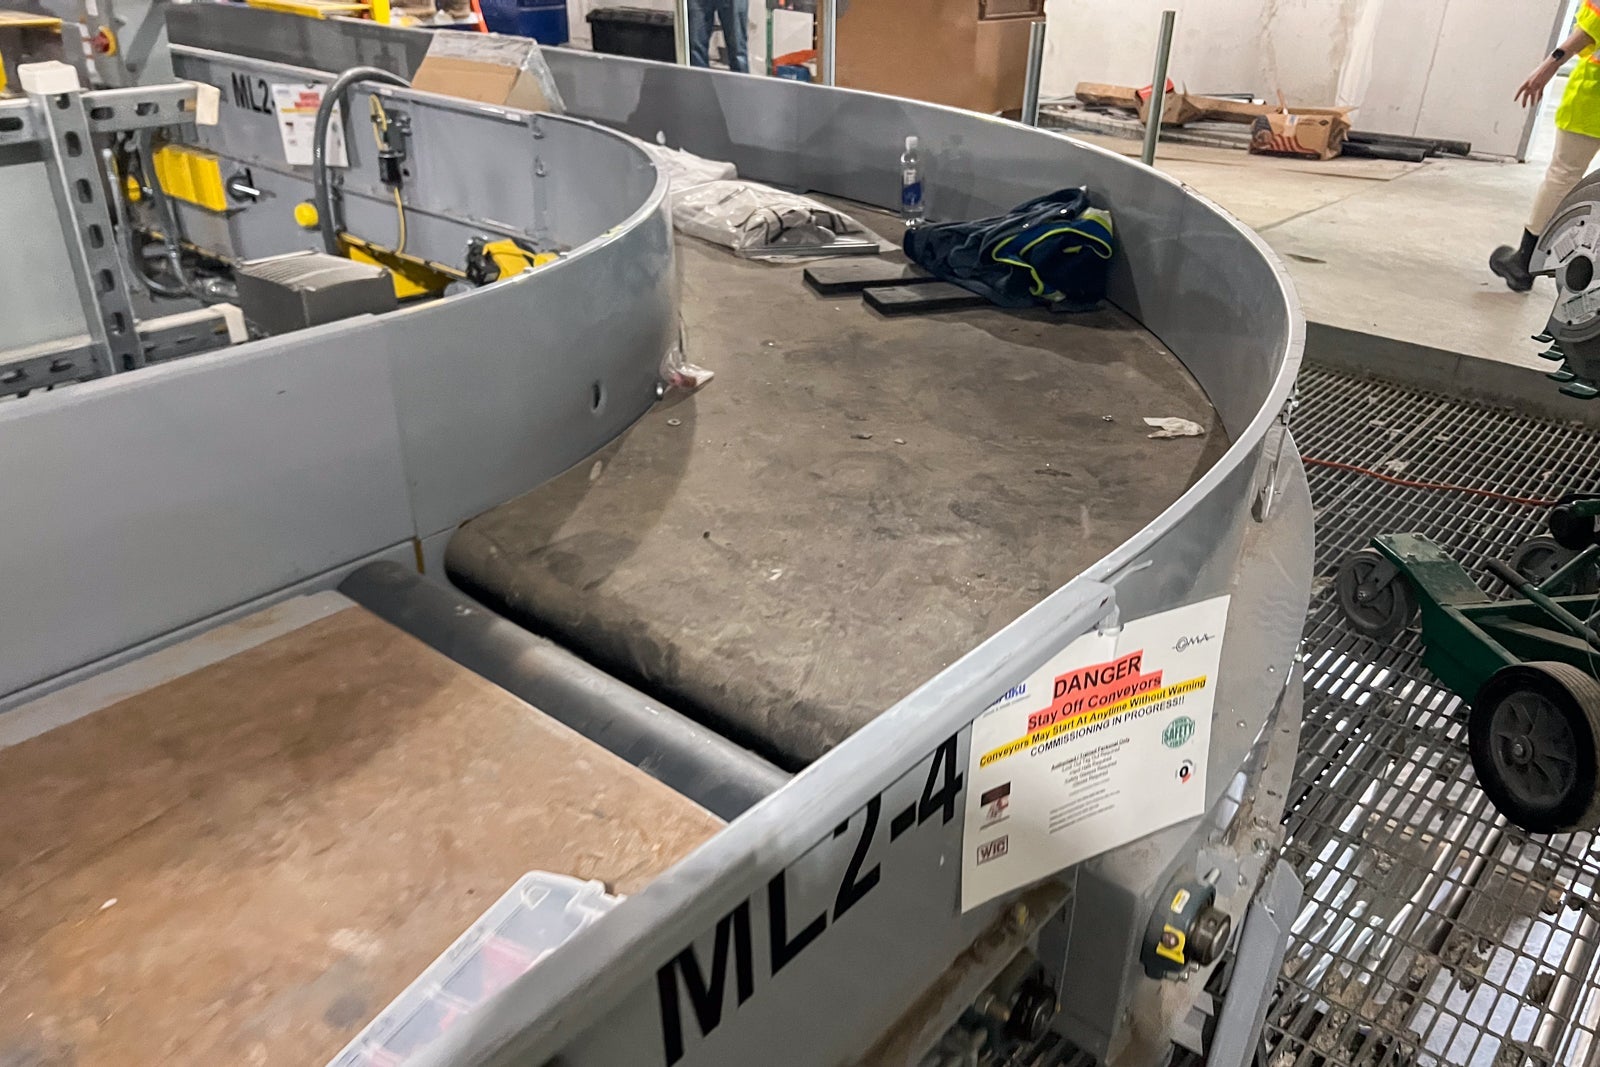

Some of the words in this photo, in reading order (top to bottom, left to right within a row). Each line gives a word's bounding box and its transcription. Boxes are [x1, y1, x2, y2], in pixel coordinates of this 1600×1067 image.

[1028, 710, 1057, 730] Stay
[1062, 698, 1084, 716] Off
[1088, 676, 1161, 708] Conveyors
[1054, 655, 1141, 699] DANGER
[980, 740, 1029, 767] Conveyors
[1032, 732, 1050, 745] May
[1053, 720, 1074, 733] Start
[1076, 714, 1087, 725] At
[1090, 703, 1127, 722] Anytime
[1130, 690, 1165, 707] Without
[1168, 679, 1206, 696] Warning
[1030, 720, 1110, 757] COMMISSIONING
[1112, 715, 1122, 725] IN
[1124, 696, 1185, 721] PROGRESS!!
[1163, 721, 1194, 741] SAFETY
[657, 731, 963, 1067] ML2-4
